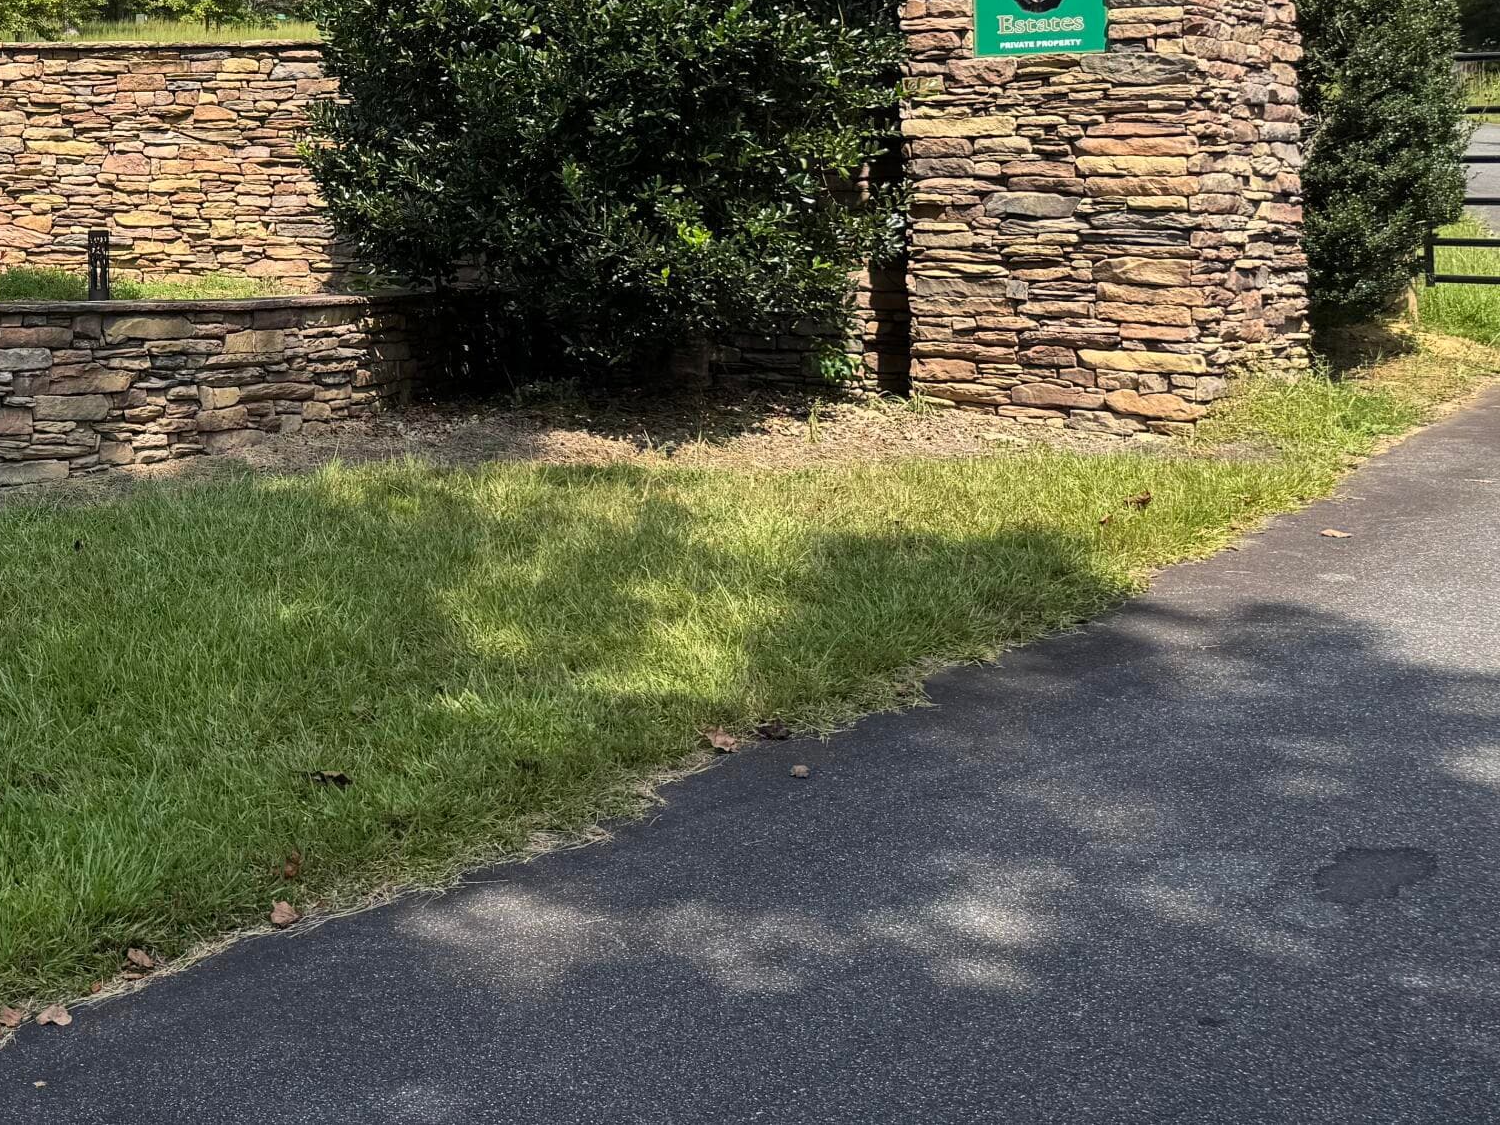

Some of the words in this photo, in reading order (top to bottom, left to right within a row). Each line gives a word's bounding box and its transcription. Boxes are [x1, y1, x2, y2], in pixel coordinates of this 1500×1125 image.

[996, 15, 1085, 34] Estates
[1000, 40, 1034, 49] PRIVATE
[1036, 39, 1082, 48] PROPERTY
